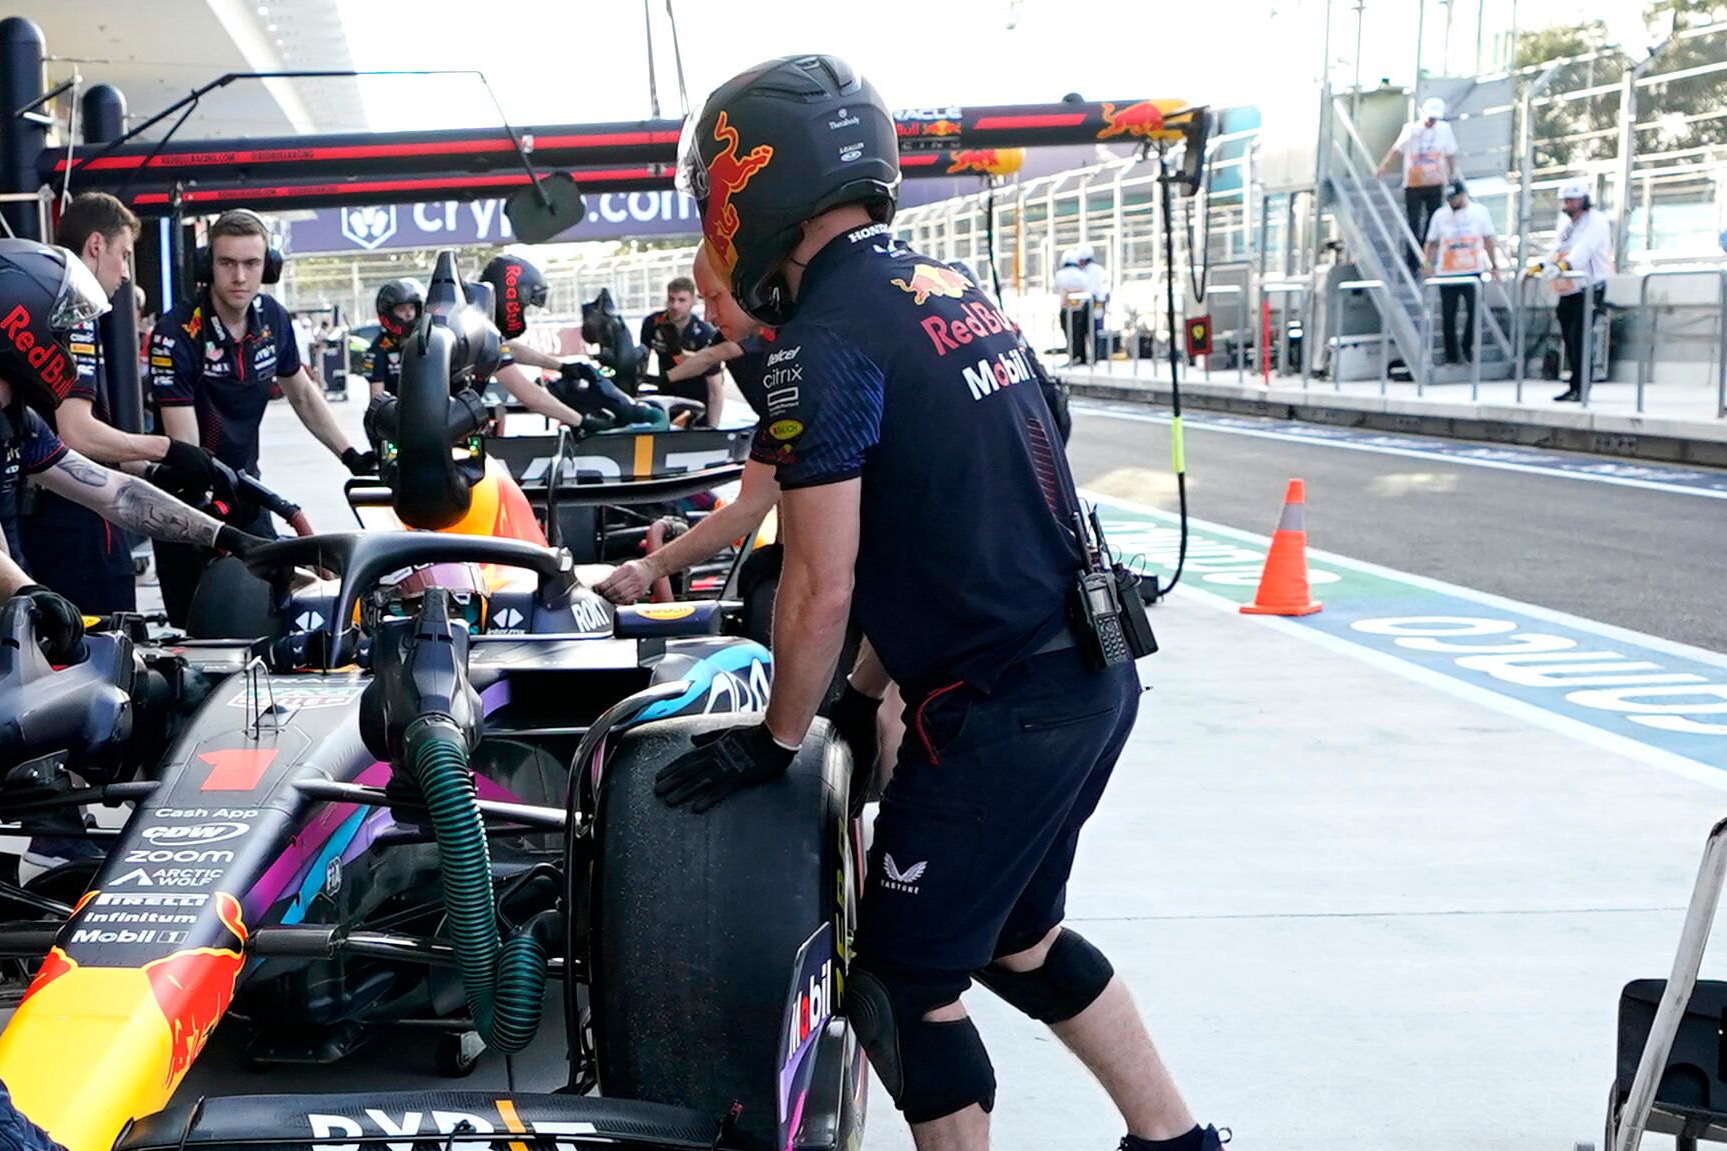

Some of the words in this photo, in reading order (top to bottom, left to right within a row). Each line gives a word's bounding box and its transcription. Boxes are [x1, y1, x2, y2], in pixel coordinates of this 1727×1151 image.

[198, 749, 279, 791] 1
[155, 808, 208, 818] Cash
[212, 808, 259, 819] App
[124, 850, 235, 863] zoom
[152, 868, 224, 878] ARCTIC
[158, 877, 213, 886] WOLF
[95, 893, 210, 906] PIRELLI
[71, 929, 157, 943] Mobil
[789, 958, 832, 1061] Mobil
